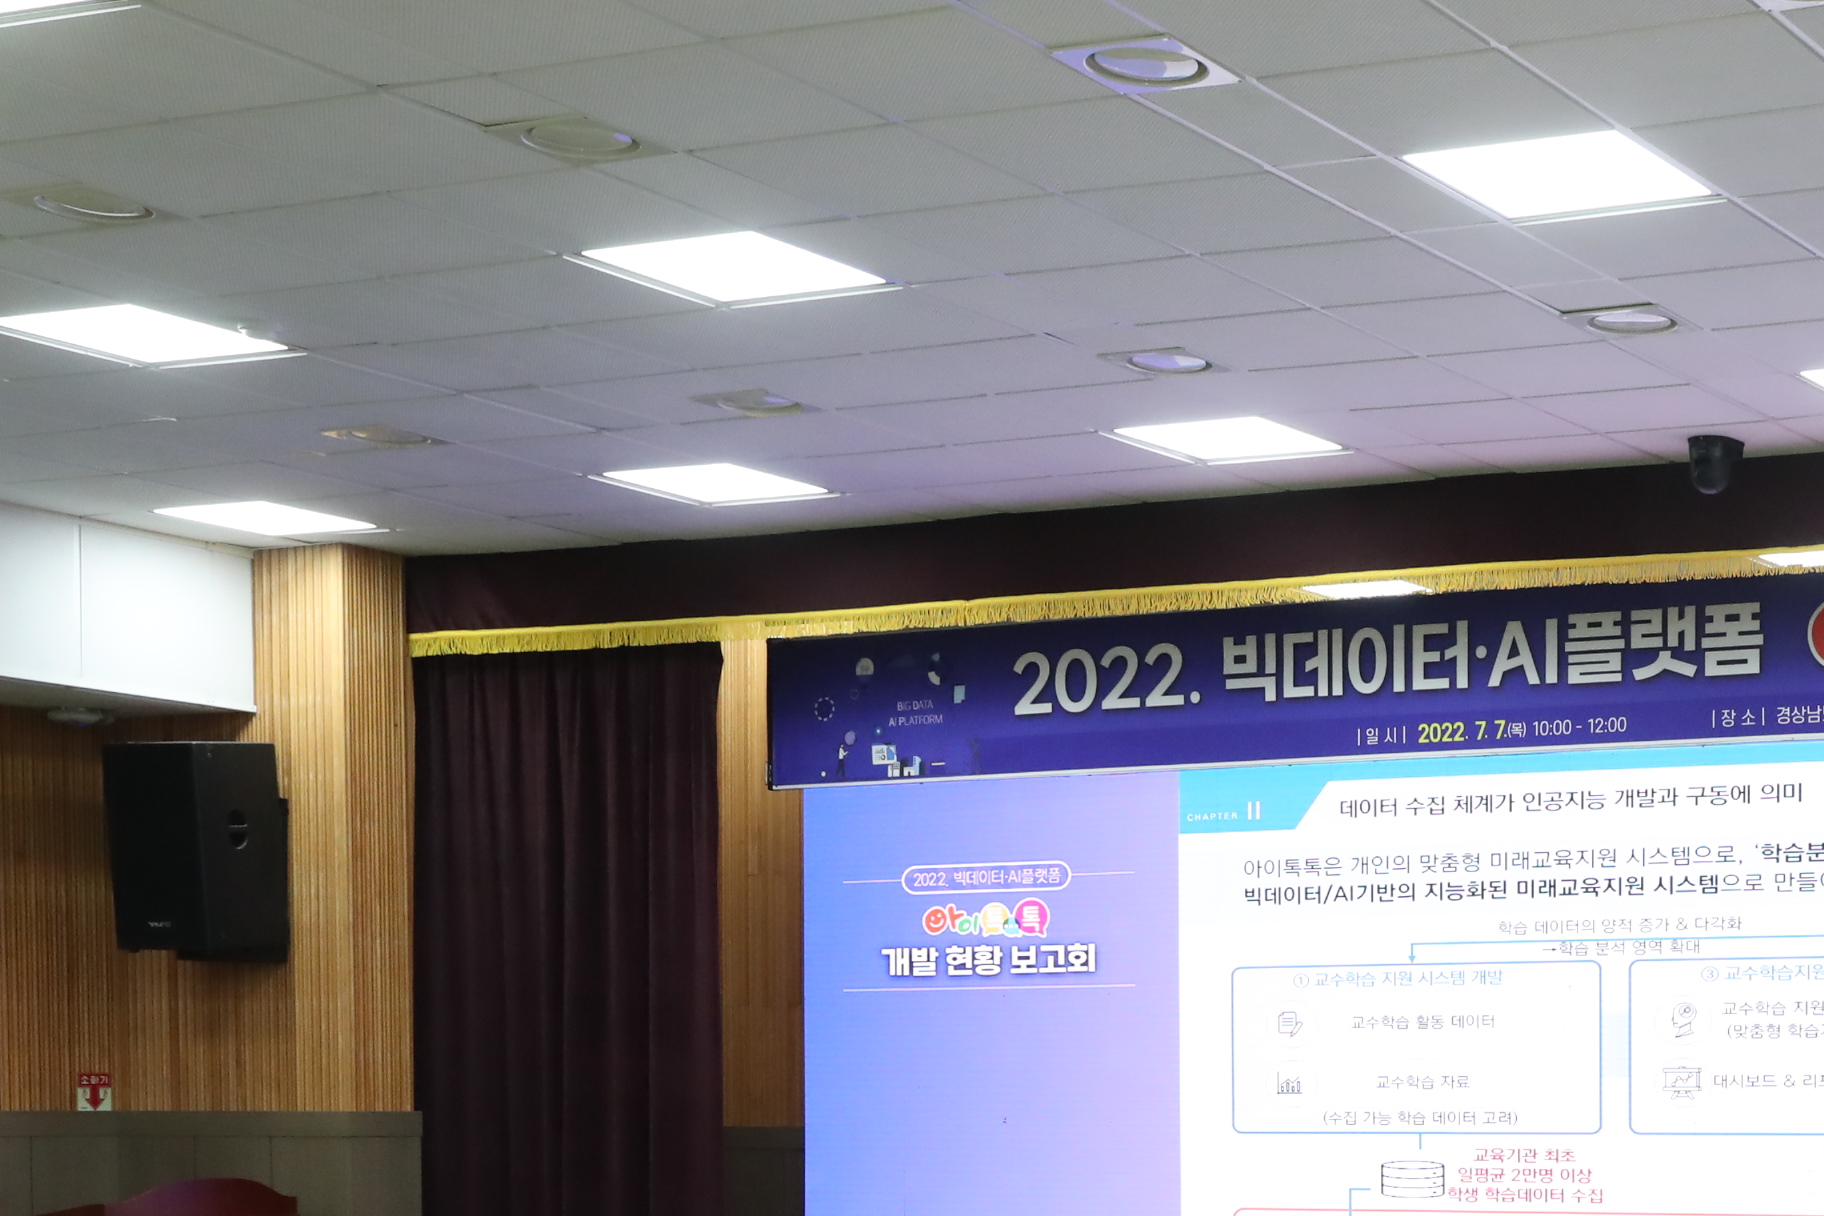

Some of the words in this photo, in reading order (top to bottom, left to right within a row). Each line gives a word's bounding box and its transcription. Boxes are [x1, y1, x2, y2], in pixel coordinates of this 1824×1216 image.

[1012, 641, 1202, 716] 2022.
[1223, 601, 1765, 702] 빅데이터·AI플랫폼
[913, 700, 933, 710] DATA
[898, 714, 943, 726] PLATFORM
[1418, 721, 1469, 744] 2022.
[1533, 719, 1573, 737] 10:00
[1588, 716, 1627, 734] 12:00
[1340, 798, 1398, 818] 데이터
[1405, 796, 1445, 816] 수집
[1454, 793, 1515, 814] 체계가
[1523, 790, 1606, 812] 인공지능
[1615, 787, 1679, 808] 개발과
[1686, 784, 1752, 806] 구동에
[1761, 782, 1803, 803] 의미
[1187, 811, 1238, 822] CHAPTER
[1244, 856, 1343, 879] 아이톡톡은
[1351, 854, 1411, 876] 개인의
[1419, 851, 1481, 874] 맞춤형
[1491, 848, 1617, 870] 미래교육지원
[1626, 845, 1743, 867] 시스템으로,
[913, 872, 949, 887] 2022.
[954, 867, 1062, 886] 빅데이터·AI플랫폼
[1244, 882, 1416, 906] 빅데이터/AI기반의
[1425, 880, 1508, 902] 지능화된
[1517, 876, 1645, 899] 미래교육지원
[1654, 873, 1765, 895] 시스템으로
[922, 897, 1050, 937] 아이톡톡
[1499, 920, 1528, 935] 학습
[1535, 918, 1596, 935] 데이터의
[1601, 917, 1633, 934] 양적
[1639, 917, 1669, 933] 증가
[1695, 916, 1742, 932] 다각화
[1595, 940, 1625, 956] 분석
[1632, 939, 1662, 955] 영역
[1669, 939, 1700, 955] 확대
[881, 947, 939, 977] 개발
[945, 944, 1003, 976] 현황
[1010, 942, 1096, 974] 보고회
[1314, 972, 1376, 988] 교수학습
[1382, 971, 1413, 987] 지원
[1418, 970, 1466, 986] 시스템
[1471, 969, 1504, 985] 개발
[1722, 1001, 1786, 1017] 교수학습
[1351, 1014, 1411, 1030] 교수학습
[1416, 1014, 1445, 1030] 활동
[1451, 1014, 1495, 1029] 데이터
[1376, 1074, 1436, 1090] 교수학습
[1441, 1074, 1471, 1089] 자료
[1713, 1074, 1777, 1089] 대시보드
[1363, 1111, 1392, 1126] 가능
[1397, 1111, 1426, 1126] 학습
[1432, 1110, 1476, 1126] 데이터
[1473, 1148, 1538, 1164] 교육기관
[1544, 1148, 1576, 1163] 최초
[1458, 1168, 1507, 1183] 일평균
[1511, 1167, 1555, 1184] 2만명
[1560, 1168, 1592, 1184] 이상
[1447, 1187, 1480, 1203] 학생
[1485, 1187, 1565, 1204] 학습데이터
[1571, 1187, 1604, 1204] 수집
